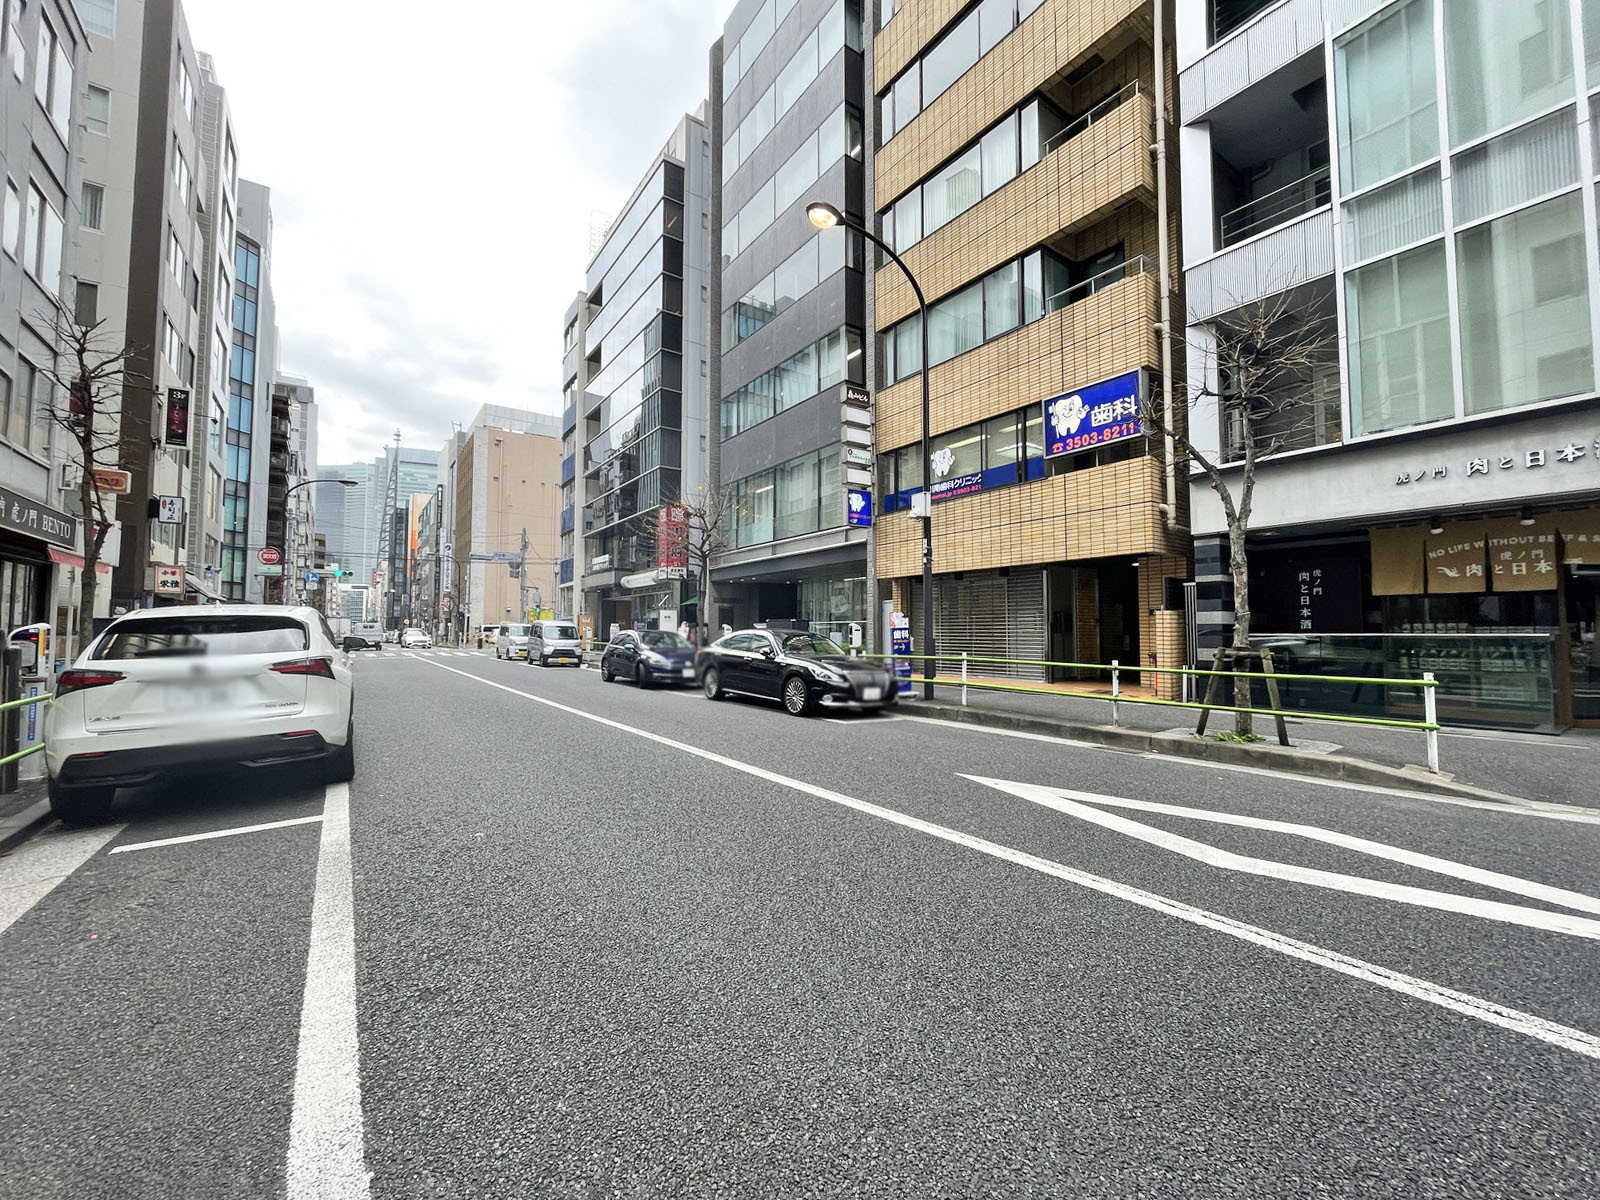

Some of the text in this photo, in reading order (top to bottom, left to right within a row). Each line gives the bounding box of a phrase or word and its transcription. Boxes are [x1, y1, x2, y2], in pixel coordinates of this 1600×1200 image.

[1091, 394, 1138, 427] 歯科
[1066, 421, 1135, 450] 3503-8211
[1395, 439, 1600, 485] 虎ノ門 肉と日本
[11, 501, 37, 529] 虎ノ門
[42, 514, 70, 538] BENTO
[1429, 549, 1445, 559] NO
[1448, 543, 1471, 553] LIFE
[1473, 535, 1534, 549] WITHOUT
[1500, 549, 1544, 561] 虎ノ門
[1312, 569, 1323, 595] 虎ノ門
[1466, 558, 1583, 577] 肉と日本
[1298, 572, 1312, 630] 肉と日本酒
